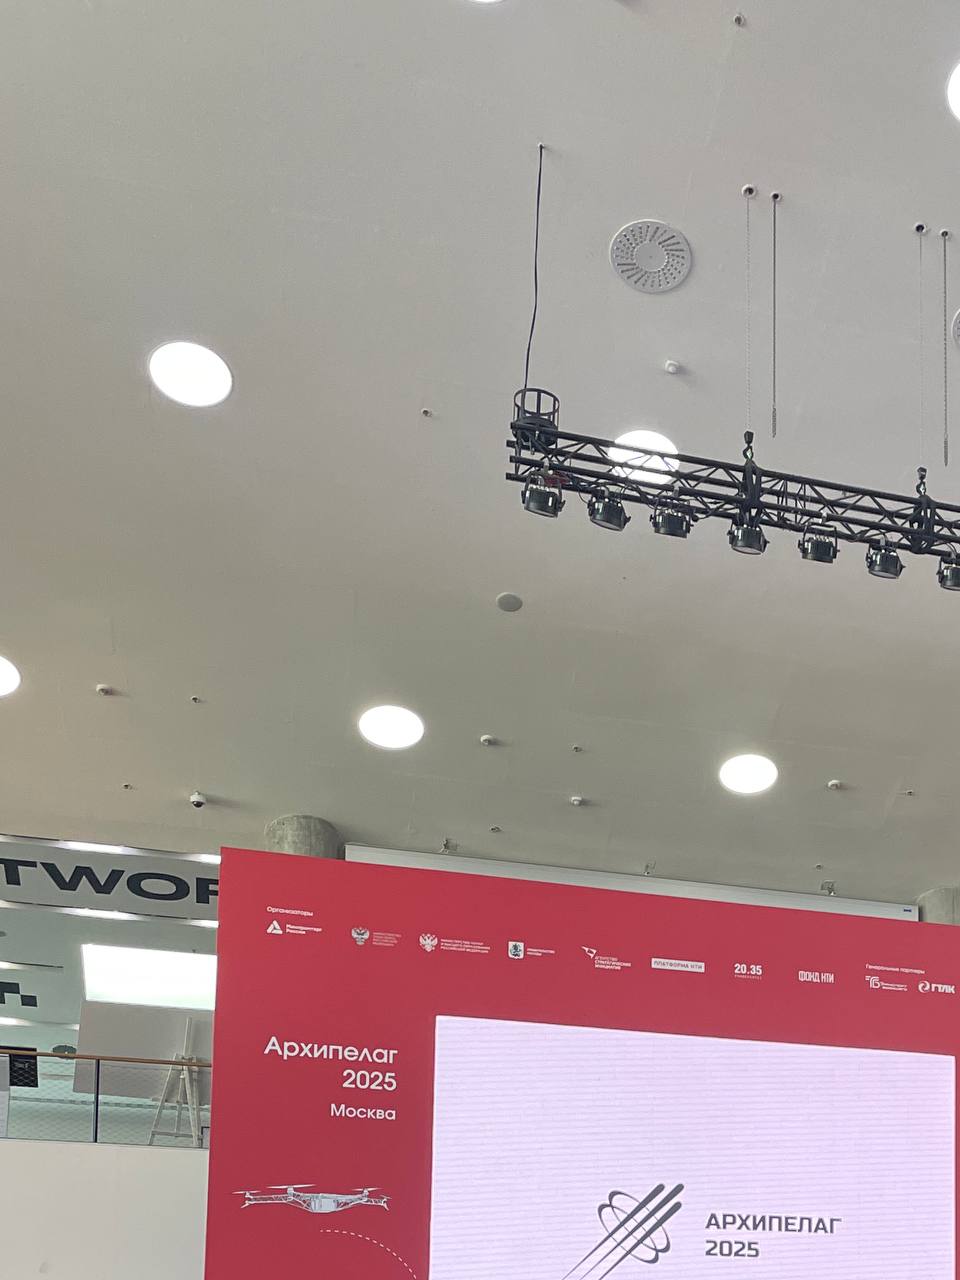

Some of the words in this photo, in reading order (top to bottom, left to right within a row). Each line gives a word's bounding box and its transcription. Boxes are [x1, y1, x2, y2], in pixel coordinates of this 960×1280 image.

[734, 963, 763, 976] 20.35
[263, 1035, 398, 1065] Архипелаг
[342, 1068, 397, 1091] 2025
[330, 1103, 396, 1121] Москва
[705, 1213, 842, 1234] АРХИПЕЛАГ
[705, 1240, 760, 1258] 2025
